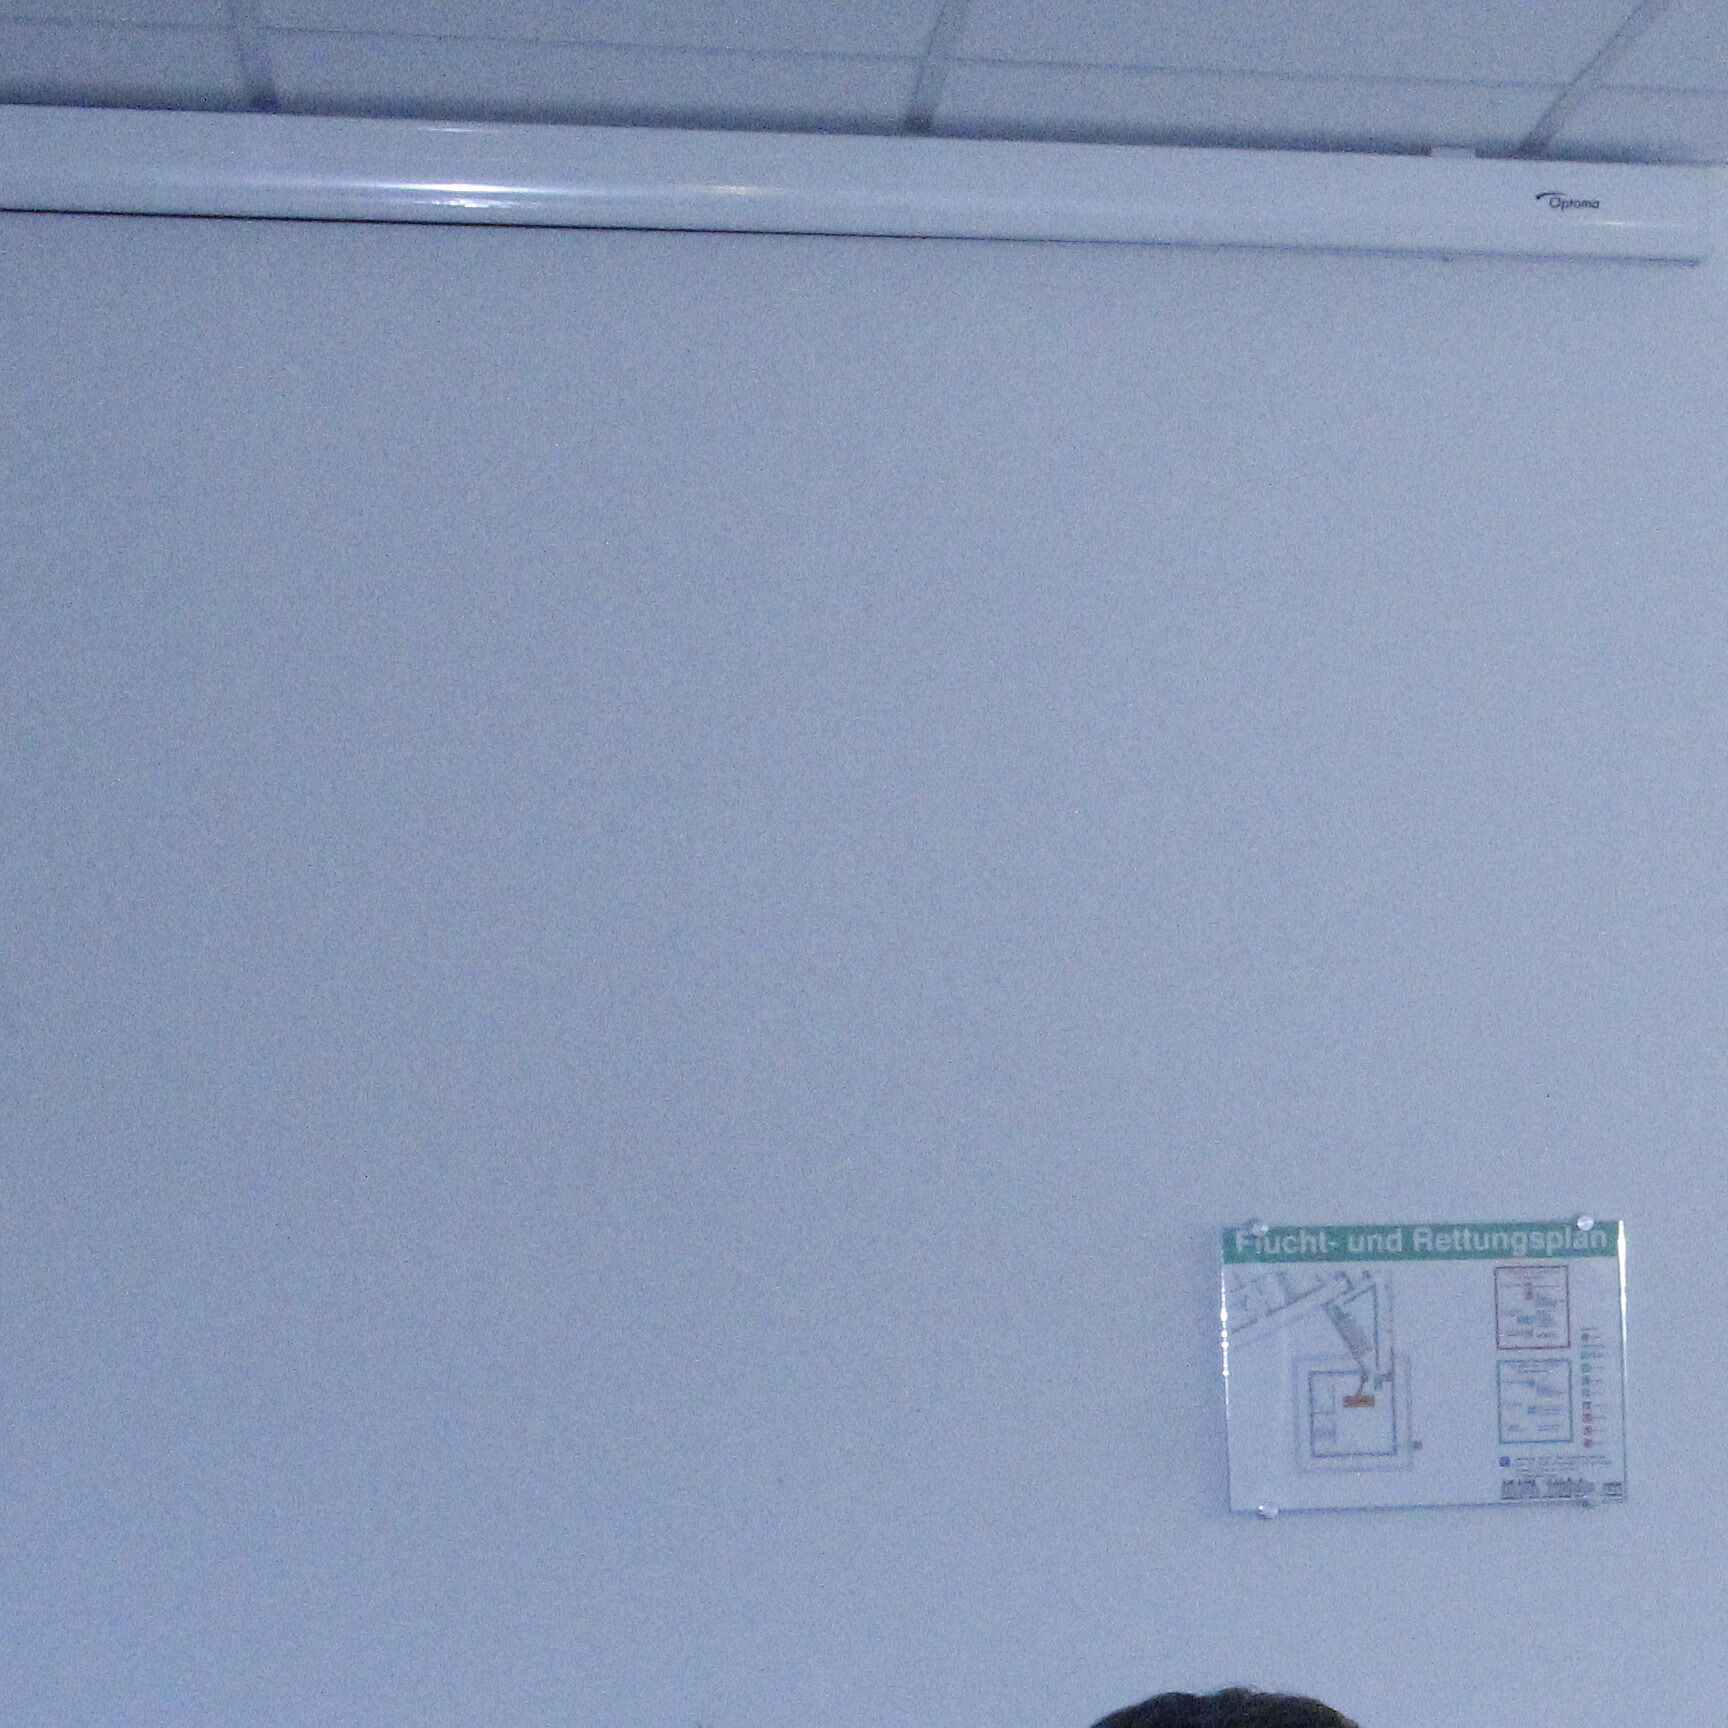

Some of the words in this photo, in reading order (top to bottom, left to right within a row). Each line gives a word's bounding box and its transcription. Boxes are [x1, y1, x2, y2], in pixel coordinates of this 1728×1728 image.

[1549, 197, 1600, 211] Optoma
[1235, 1229, 1338, 1254] Flucht-
[1347, 1229, 1403, 1252] und
[1412, 1226, 1607, 1257] Rettungsplan
